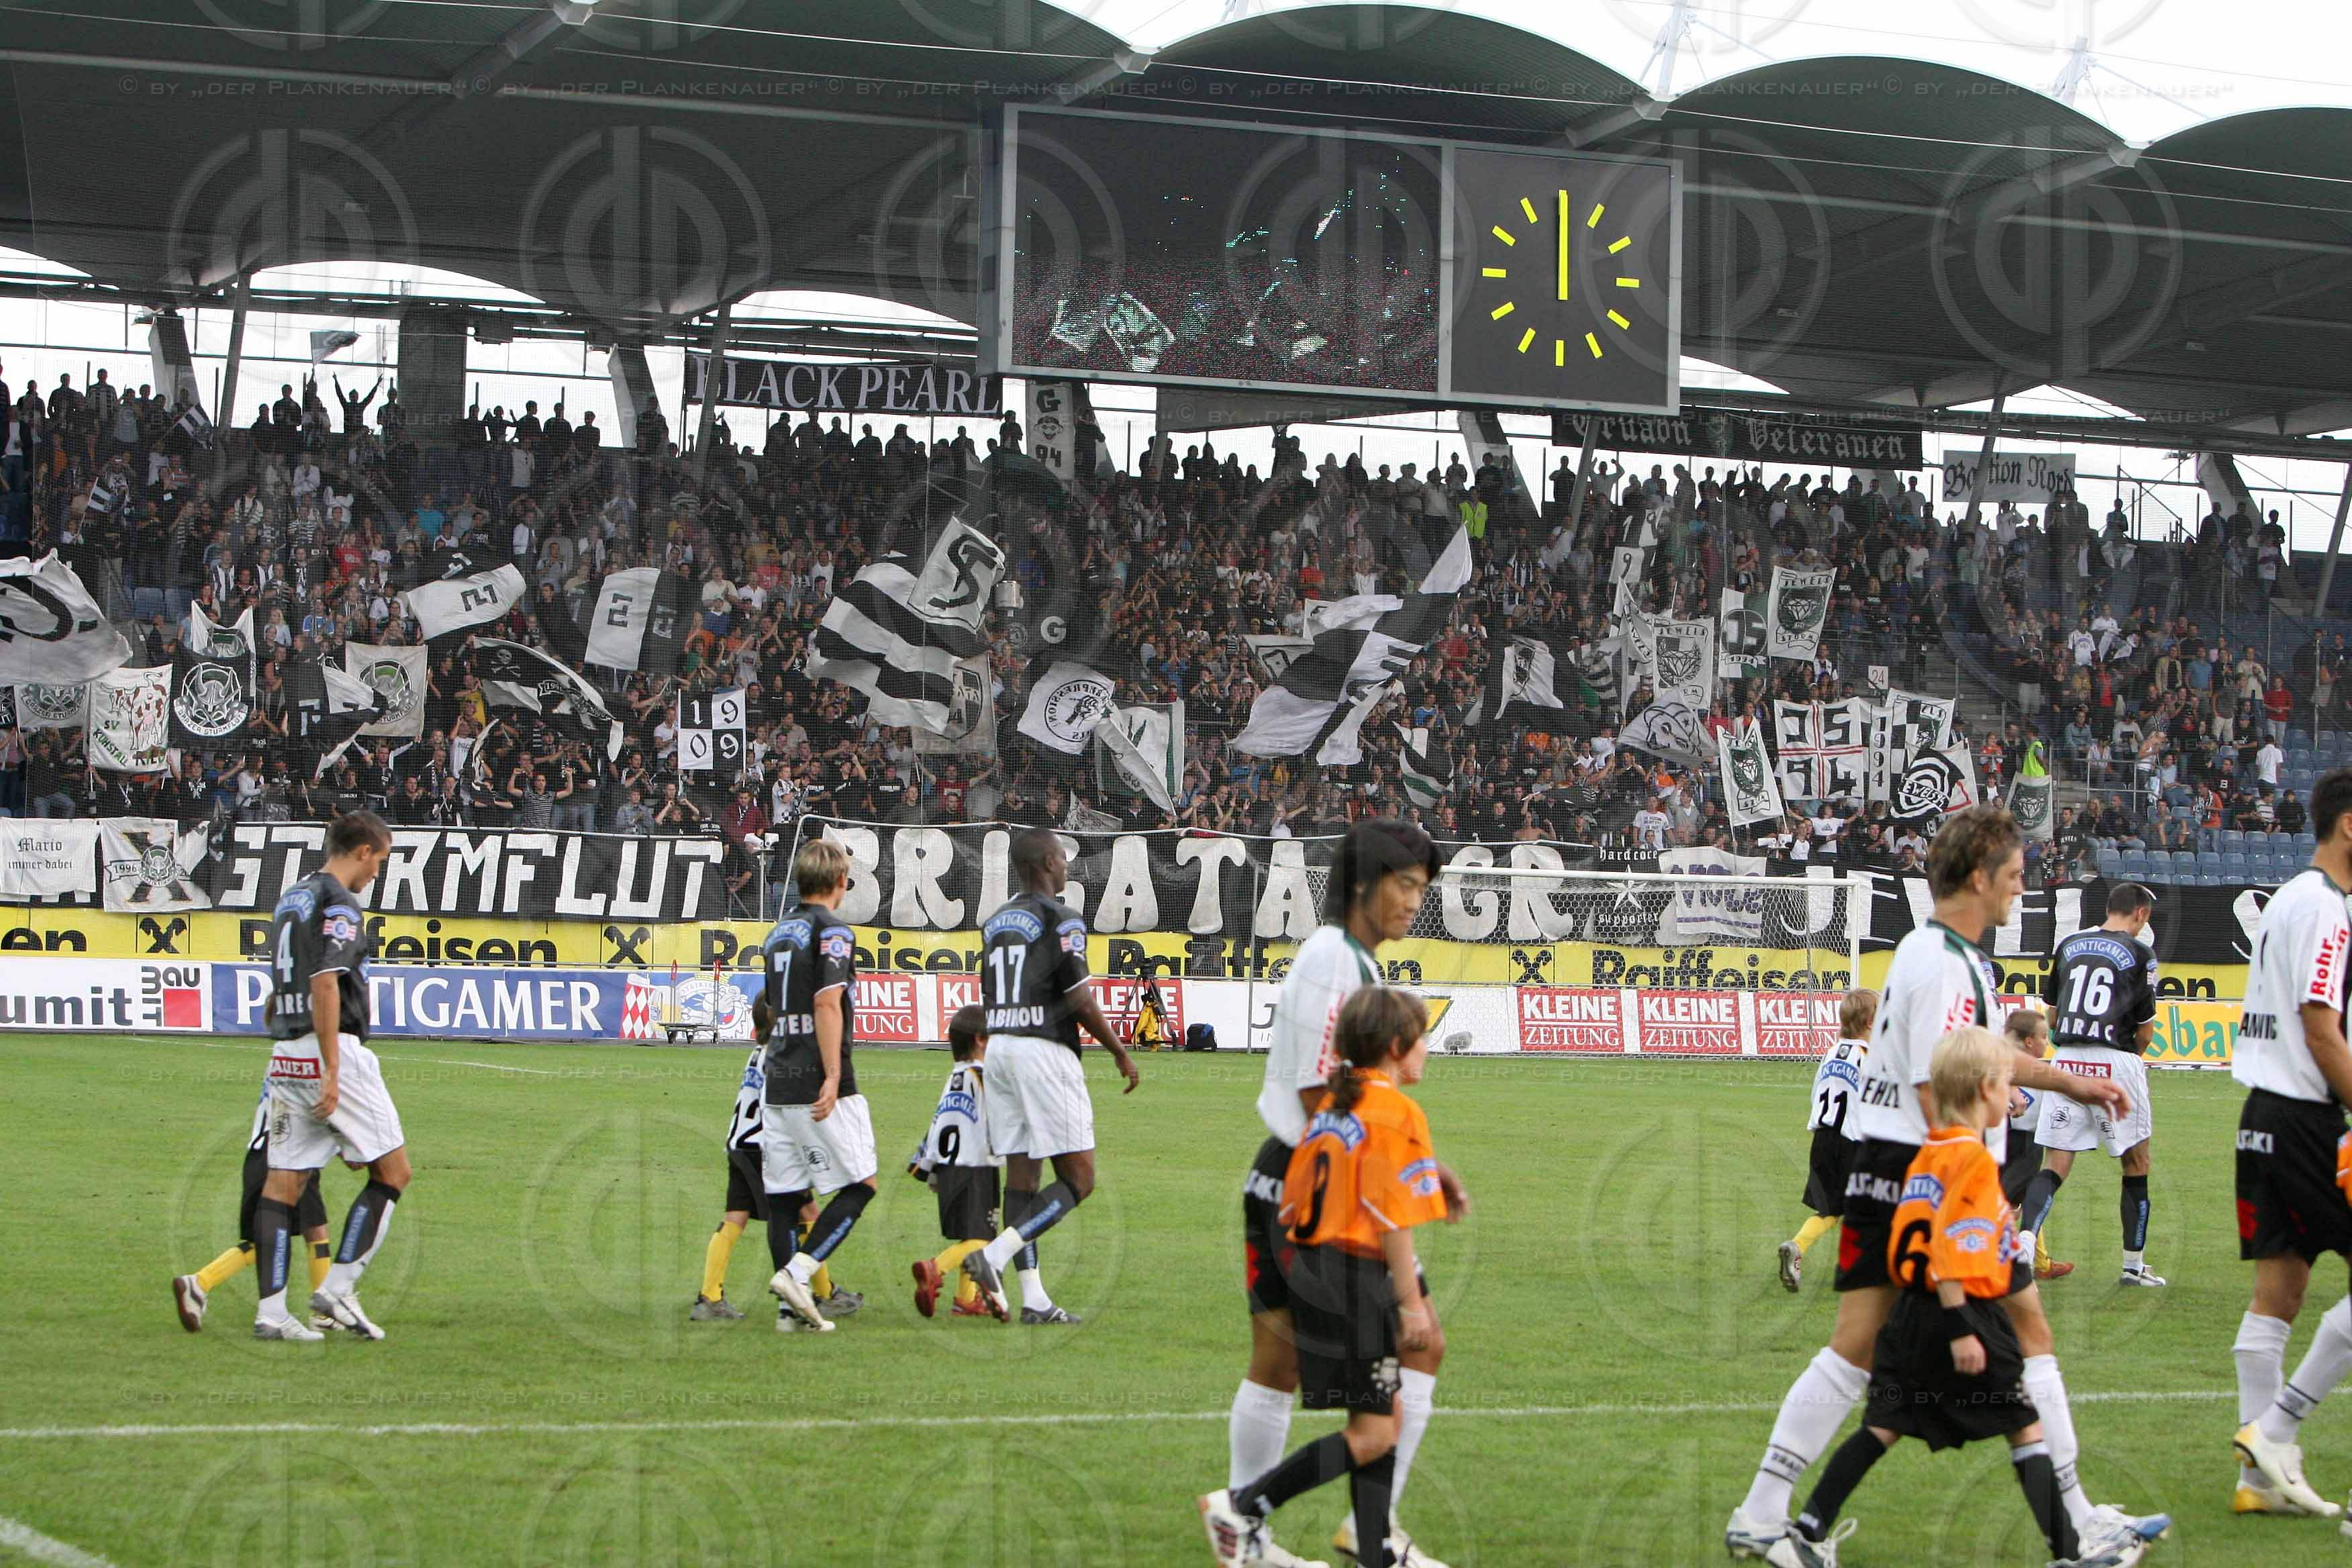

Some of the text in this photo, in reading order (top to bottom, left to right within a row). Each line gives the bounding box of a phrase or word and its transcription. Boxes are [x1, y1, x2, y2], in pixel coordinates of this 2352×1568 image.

[857, 366, 999, 415] PEARL
[1747, 418, 1906, 460] Veteranen
[1945, 453, 2022, 497] Bation
[1871, 669, 1885, 685] 24
[17, 837, 63, 853] Mario
[45, 859, 73, 870] dabei
[219, 826, 724, 919] STRMFLUT
[276, 920, 294, 983] 4
[701, 930, 983, 973] Raeisen
[1591, 949, 1850, 991] Raiffeisen
[2065, 939, 2135, 971] PUNTIGAMER
[774, 950, 792, 1011] 7
[854, 979, 913, 1008] EINE
[988, 944, 1026, 1005] 17
[2067, 964, 2114, 1016] 16
[237, 969, 604, 1032] PTIGAMER
[1523, 993, 1618, 1021] KLEINE
[1642, 996, 1736, 1024] KLEINE
[854, 1014, 914, 1035] TUNG
[1525, 1026, 1619, 1046] ZEITUNG
[1644, 1028, 1738, 1048] ZEITUNG
[1761, 1029, 1838, 1049] ZEITUN
[728, 1098, 763, 1150] 12
[1818, 1087, 1847, 1128] 11
[938, 1125, 961, 1166] 9
[1894, 1218, 1932, 1288] 6
